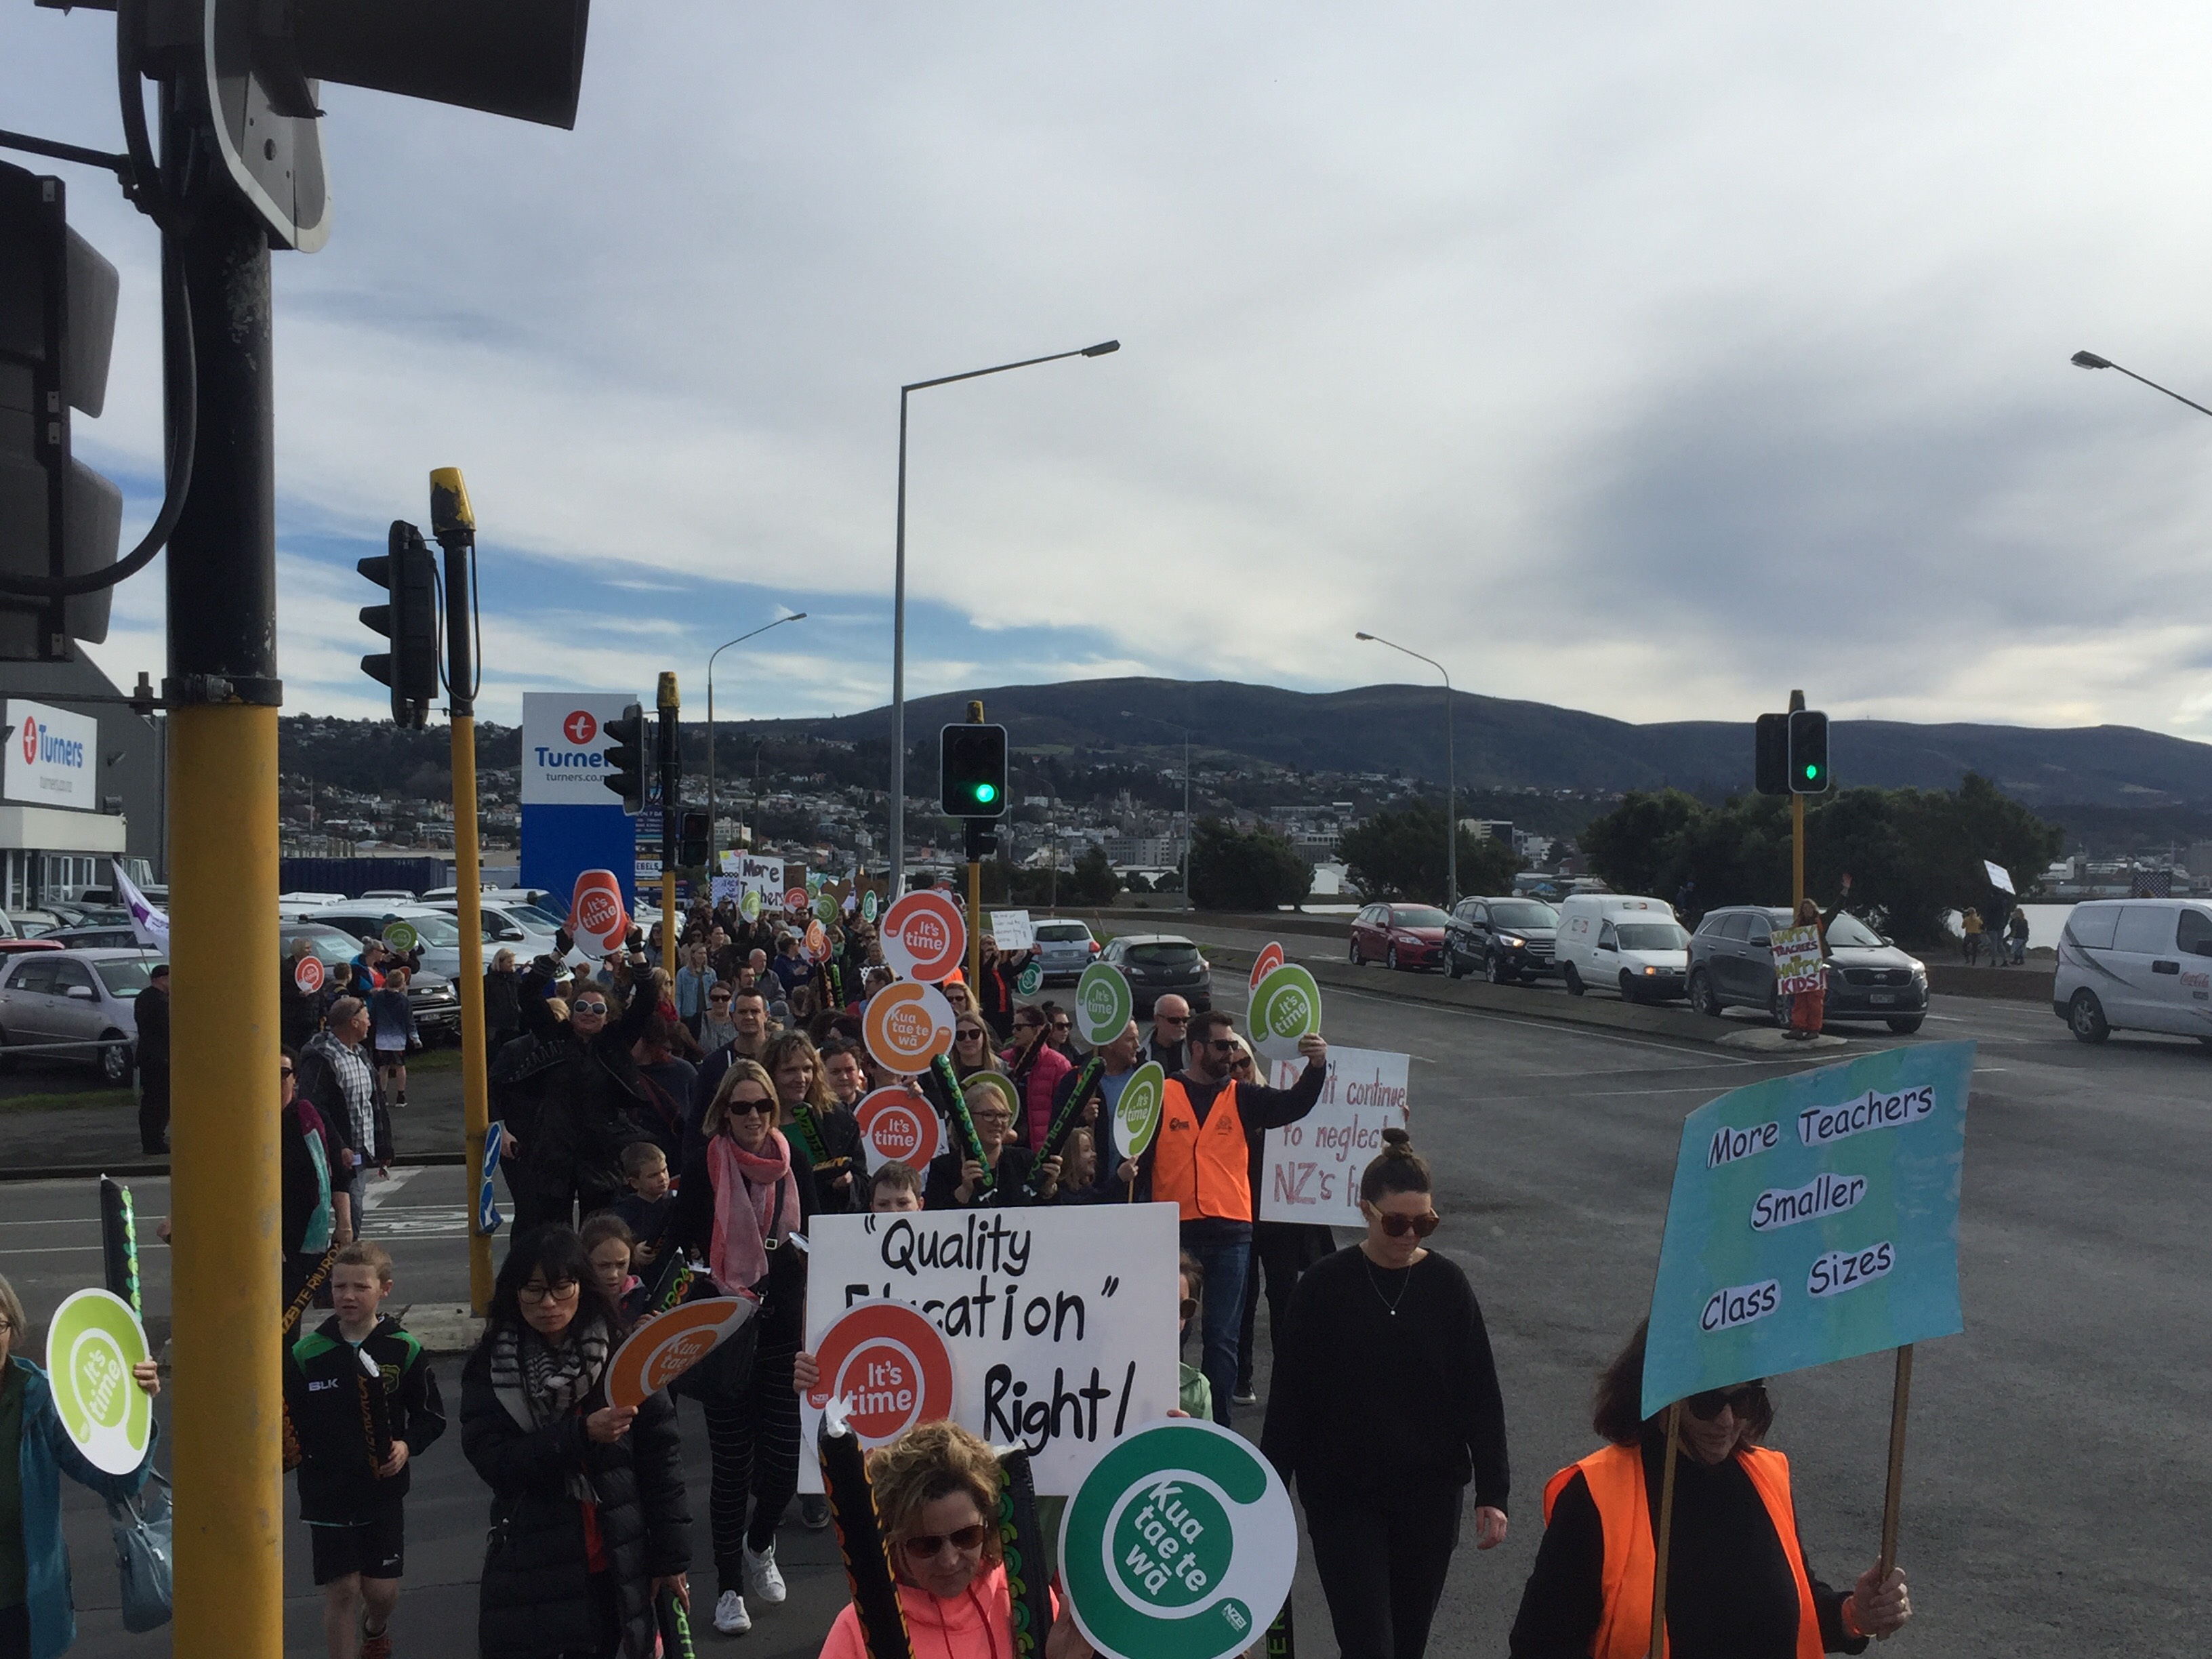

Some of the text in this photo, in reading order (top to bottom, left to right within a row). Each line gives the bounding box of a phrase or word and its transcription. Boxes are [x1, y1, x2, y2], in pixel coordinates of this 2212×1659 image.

[39, 724, 83, 768] Turners
[546, 773, 605, 781] turners.co.n
[743, 859, 780, 882] More
[588, 897, 608, 913] It's
[740, 881, 783, 906] Thers
[583, 905, 617, 928] time
[905, 931, 943, 950] time
[920, 922, 939, 937] It's
[1088, 998, 1112, 1015] time
[1095, 989, 1109, 1002] It's
[1278, 996, 1298, 1015] It's
[890, 1009, 916, 1023] Kua
[1275, 1002, 1307, 1033] time
[892, 1022, 914, 1033] tae
[916, 1025, 929, 1036] te
[899, 1034, 917, 1046] wā
[1280, 1060, 1406, 1107] D't continue
[1136, 1094, 1148, 1108] It's
[889, 1118, 909, 1132] It's
[1127, 1105, 1148, 1122] time
[875, 1129, 914, 1147] time
[1708, 1086, 1933, 1168] More Teachers
[1274, 1161, 1336, 1205] NZ's
[1753, 1176, 1865, 1229] Smaller
[293, 1288, 312, 1306] TE
[1702, 1242, 1891, 1331] Class Sizes
[845, 1275, 1119, 1343] cation"
[84, 1349, 106, 1385] It's
[868, 1360, 902, 1387] It's
[89, 1359, 121, 1420] time
[308, 1378, 339, 1391] BLK
[846, 1386, 912, 1416] time
[1148, 1480, 1204, 1544] Kua
[1134, 1505, 1207, 1592] tae te
[1125, 1544, 1172, 1596] wā
